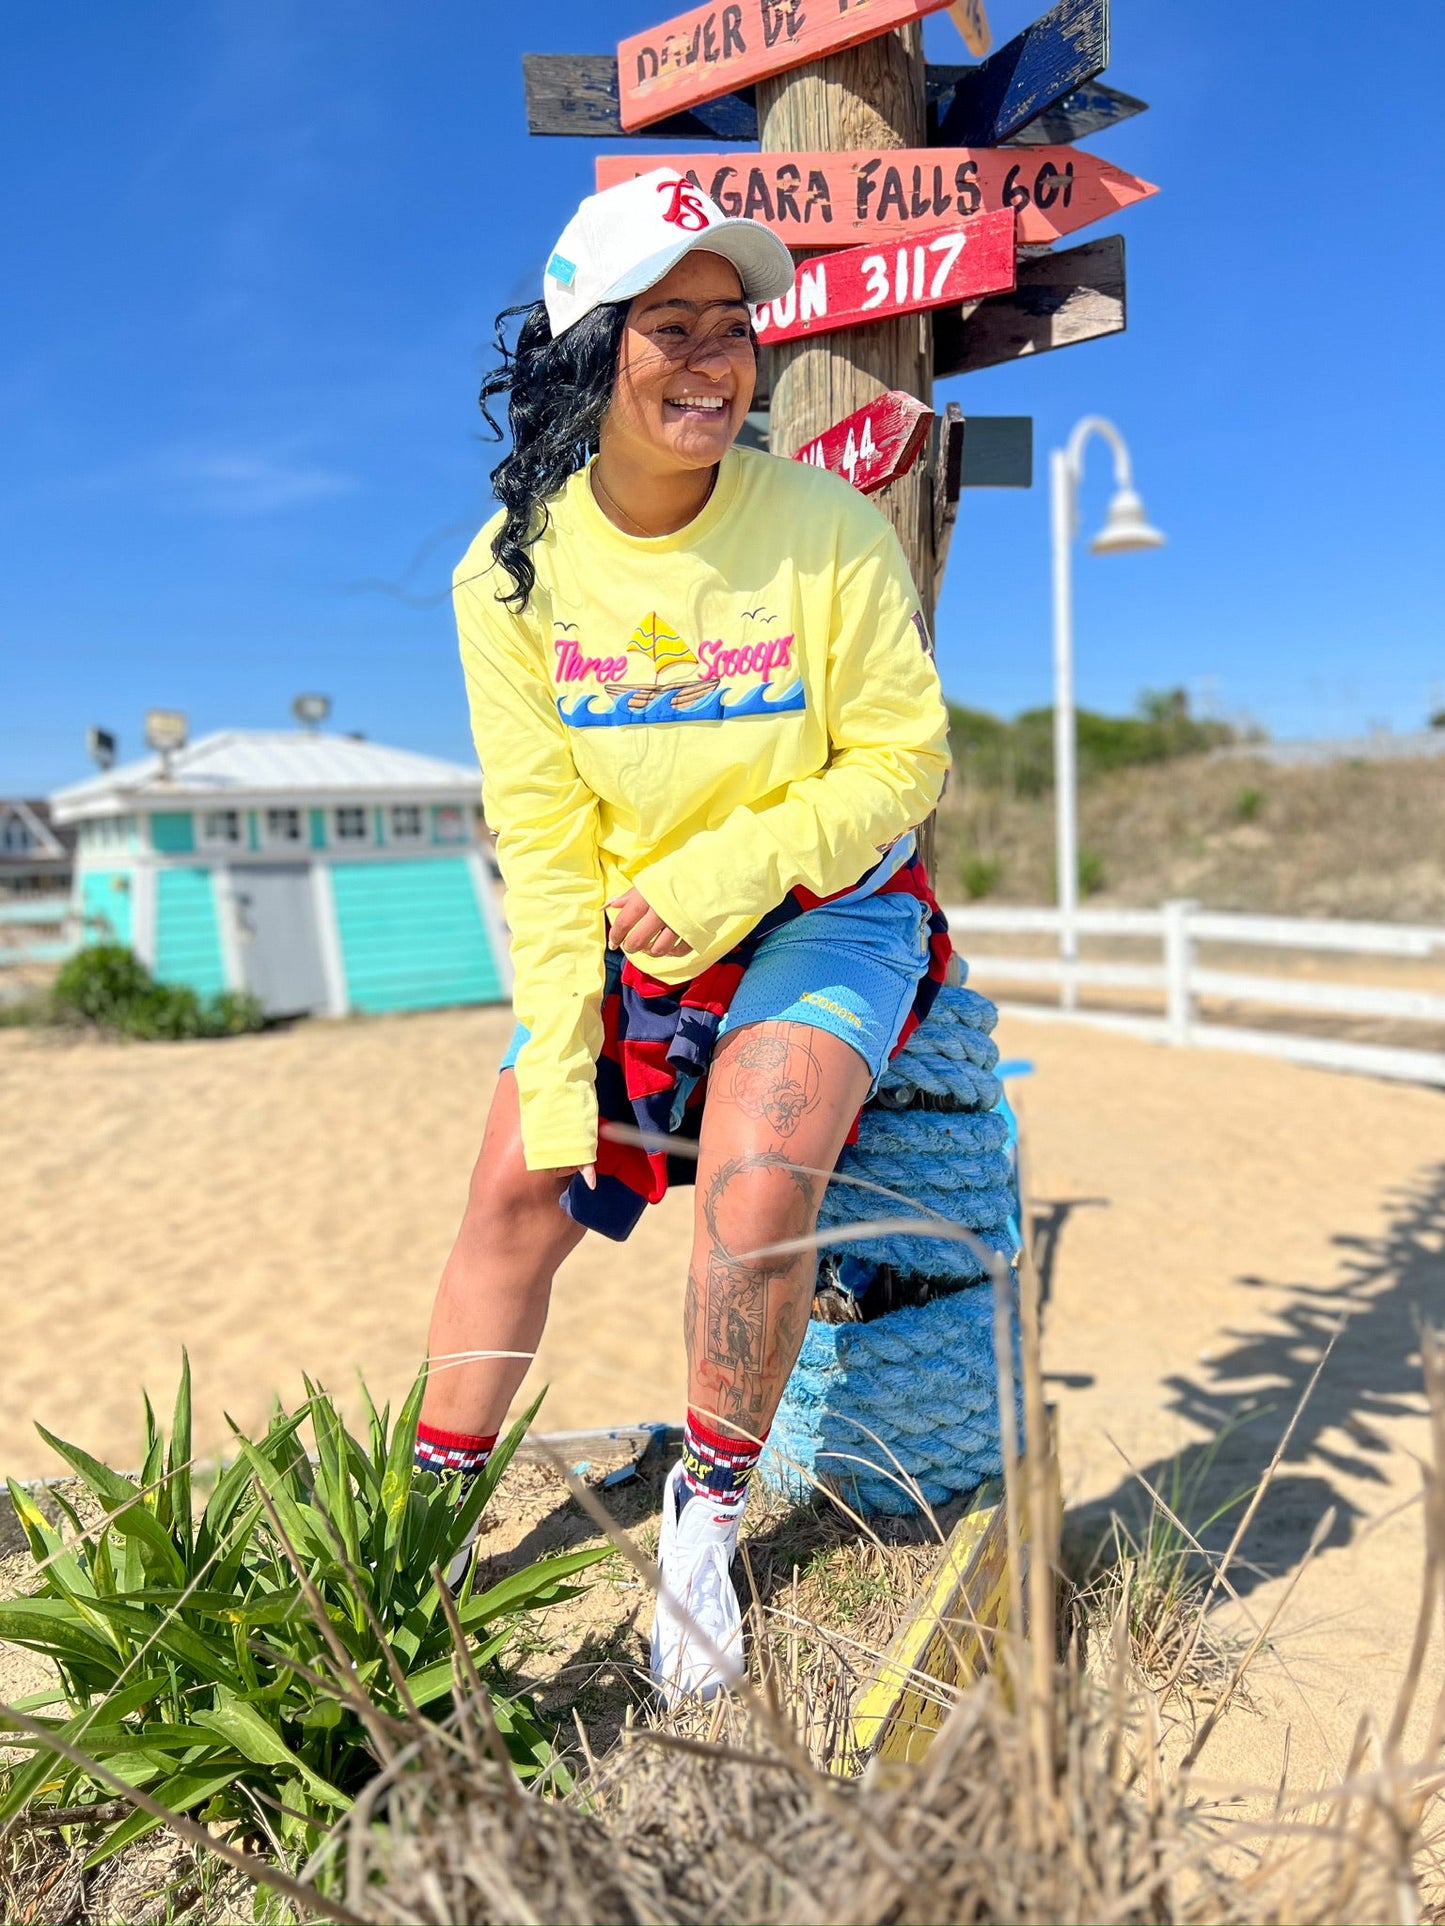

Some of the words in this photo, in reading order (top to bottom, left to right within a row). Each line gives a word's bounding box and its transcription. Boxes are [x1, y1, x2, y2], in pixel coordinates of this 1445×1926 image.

[636, 163, 832, 223] GARA
[857, 158, 981, 221] FALLS
[1002, 161, 1074, 213] 601
[861, 231, 967, 312] 3117
[842, 416, 876, 484] 44
[554, 640, 628, 683] Three
[697, 632, 794, 682] Scooops
